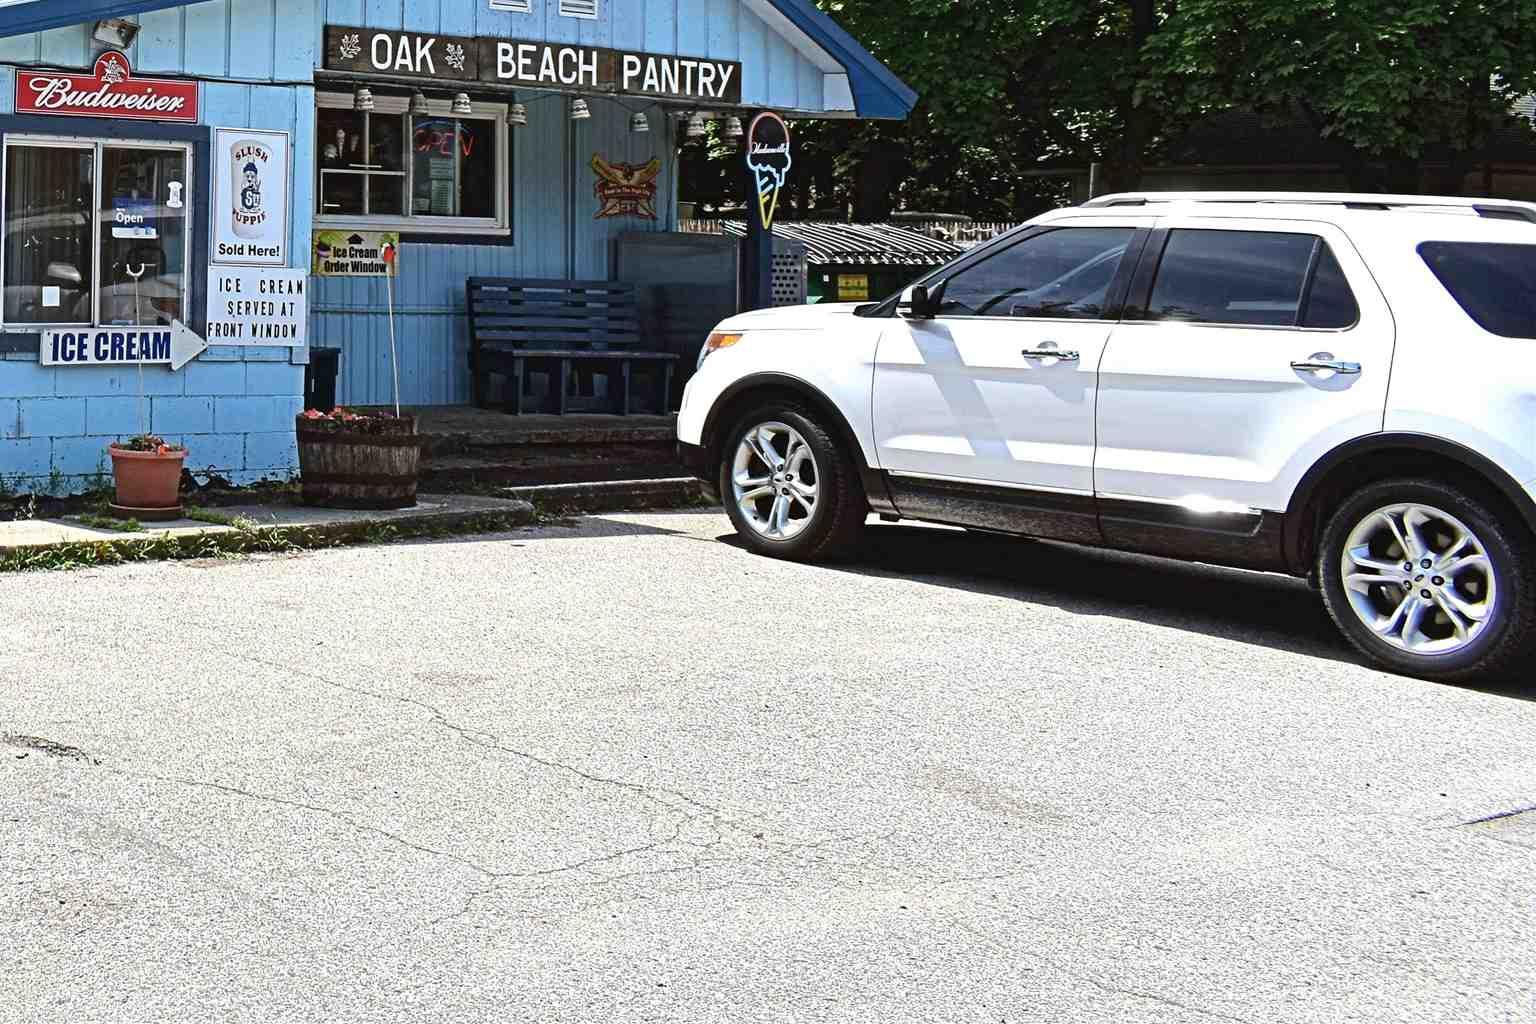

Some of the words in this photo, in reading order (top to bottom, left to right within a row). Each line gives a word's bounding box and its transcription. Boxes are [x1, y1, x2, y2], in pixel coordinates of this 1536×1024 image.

[371, 33, 437, 74] OAK
[497, 42, 598, 86] BEACH
[623, 55, 734, 99] PANTRY
[29, 77, 185, 113] Budweiser
[235, 146, 268, 163] SLUSH
[116, 212, 143, 224] Open
[218, 243, 244, 256] Sold
[248, 244, 280, 257] Here!
[333, 246, 347, 259] Ice
[348, 246, 378, 259] Cream
[324, 261, 349, 273] Order
[351, 261, 387, 273] Window
[219, 278, 241, 293] ICE
[259, 279, 303, 295] CREAM
[228, 301, 274, 316] SERVED
[280, 302, 295, 317] AT
[207, 322, 244, 337] FRONT
[252, 324, 297, 338] WINDOW
[51, 332, 89, 361] ICE
[94, 332, 172, 361] CREAM
